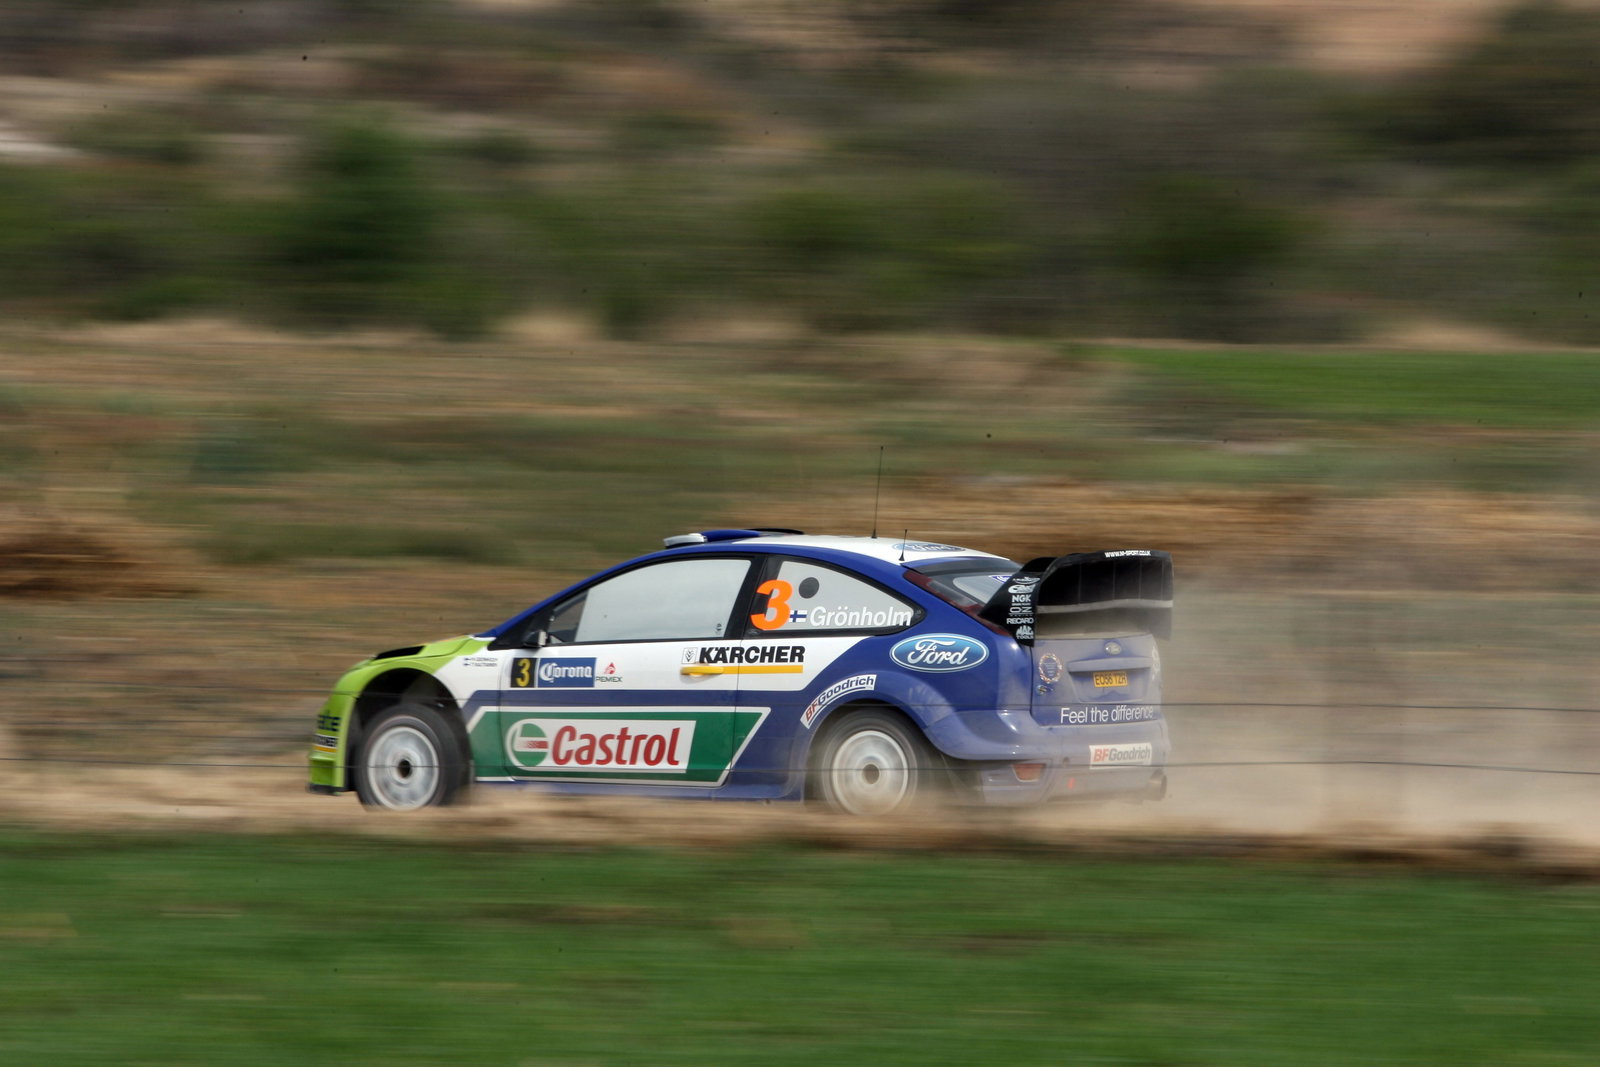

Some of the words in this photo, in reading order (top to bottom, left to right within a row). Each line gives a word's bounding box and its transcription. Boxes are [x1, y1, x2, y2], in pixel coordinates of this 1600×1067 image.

[751, 579, 793, 631] 3
[1011, 594, 1032, 603] NGK
[810, 605, 912, 627] Grönholm
[1006, 617, 1035, 625] RECARO
[699, 645, 806, 664] KÄRCHER
[907, 638, 970, 666] Ford
[516, 658, 531, 688] 3
[539, 662, 593, 684] Corona
[805, 675, 875, 722] BFGoodrich
[1060, 706, 1088, 724] Feel
[1091, 706, 1109, 722] the
[1111, 704, 1154, 721] difference
[552, 725, 682, 766] Castrol
[1093, 746, 1151, 763] BFGoodrich
